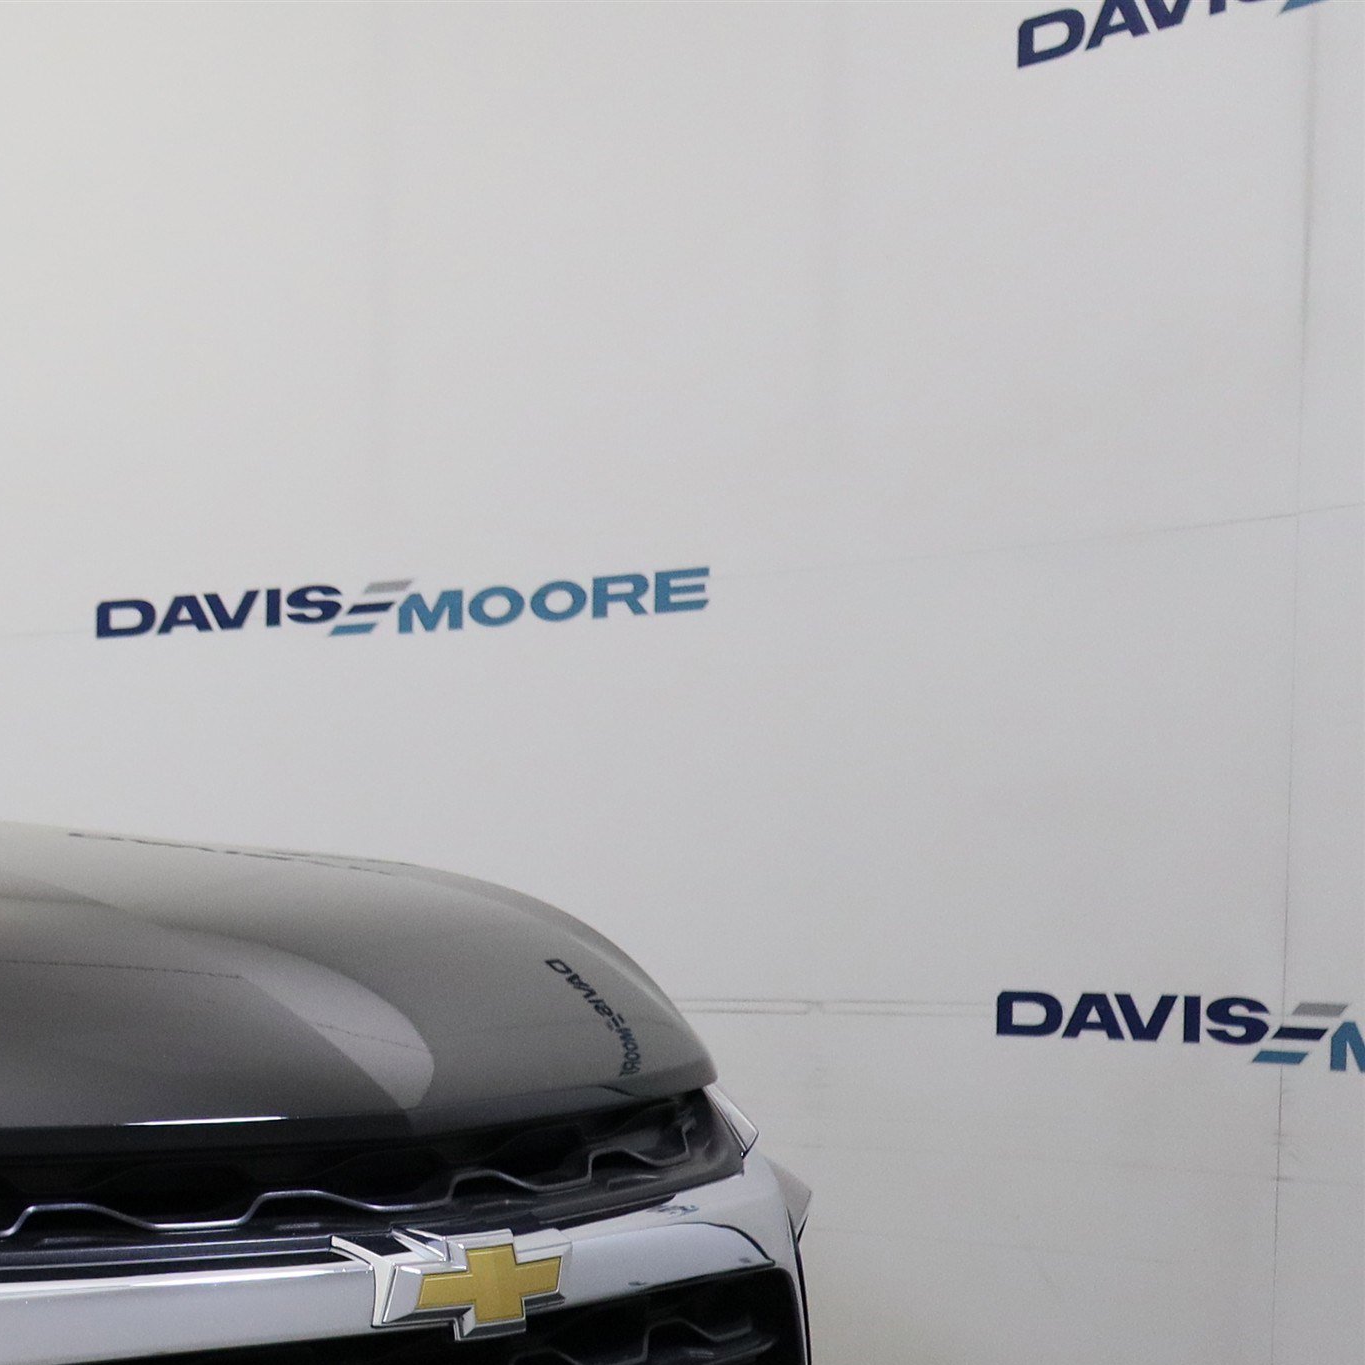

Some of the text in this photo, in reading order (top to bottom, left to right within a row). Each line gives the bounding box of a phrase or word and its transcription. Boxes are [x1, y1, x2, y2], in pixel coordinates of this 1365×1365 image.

[1017, 0, 1266, 68] DAV
[95, 566, 711, 640] DAVIS MOORE
[996, 990, 1271, 1046] DAVIS
